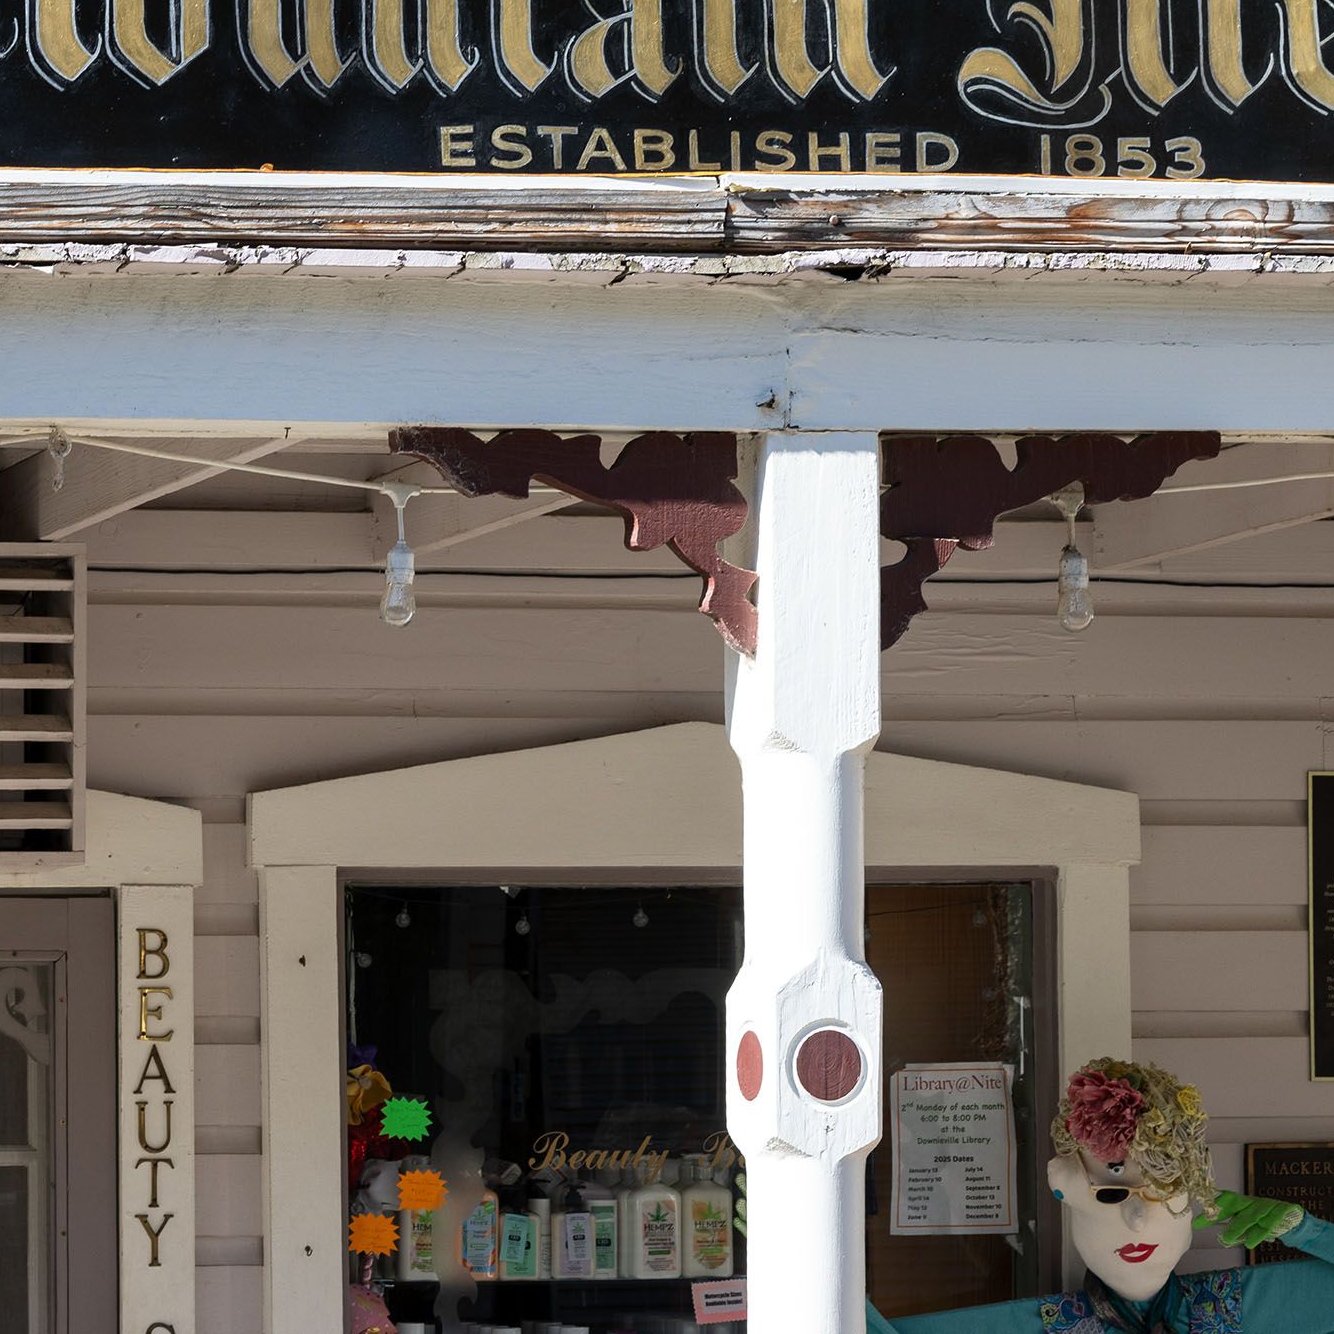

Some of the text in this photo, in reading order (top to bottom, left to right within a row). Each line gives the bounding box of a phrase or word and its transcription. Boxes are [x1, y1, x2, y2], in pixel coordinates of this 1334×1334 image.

[440, 125, 1206, 180] ESTABLISHED 1853
[903, 1074, 1002, 1094] Library@Nite
[133, 928, 176, 1267] BEAUTY
[916, 1103, 947, 1113] Monday
[950, 1103, 959, 1112] of
[961, 1102, 979, 1111] each
[982, 1102, 1005, 1110] month
[920, 1115, 939, 1123] 6:00
[952, 1114, 971, 1122] 8:00
[974, 1114, 987, 1122] PM
[953, 1125, 965, 1133] the
[917, 1136, 991, 1145] Downieville Library
[528, 1130, 670, 1185] Beauty
[934, 1155, 974, 1163] 2025 Dates
